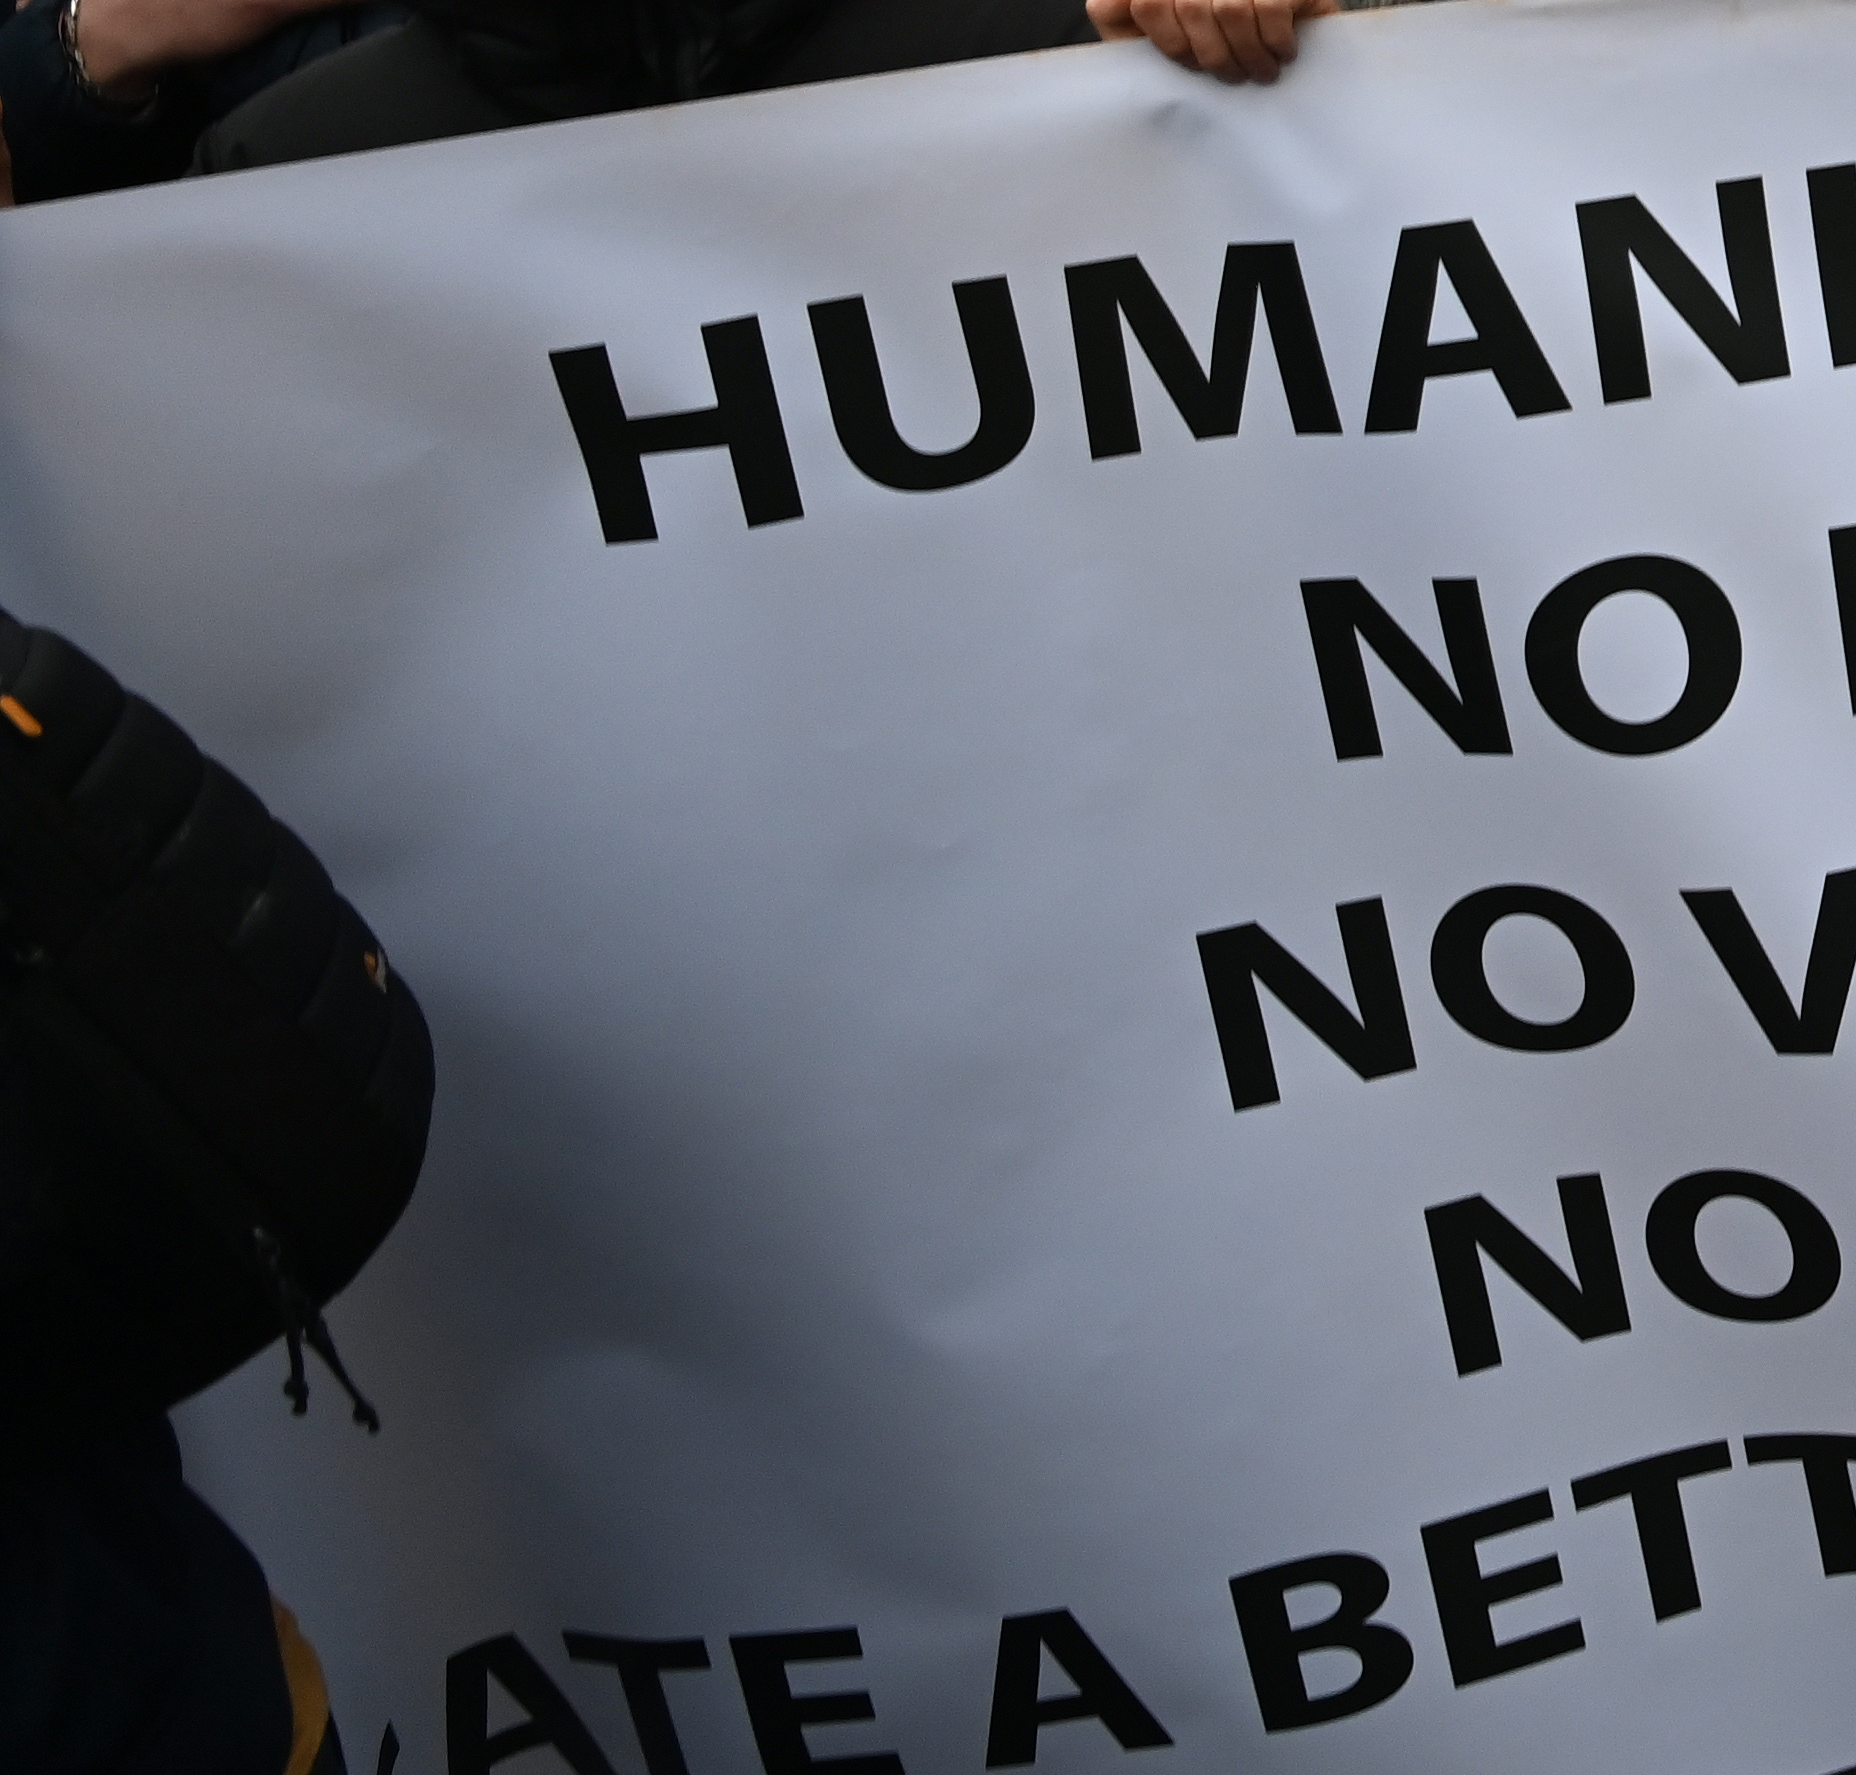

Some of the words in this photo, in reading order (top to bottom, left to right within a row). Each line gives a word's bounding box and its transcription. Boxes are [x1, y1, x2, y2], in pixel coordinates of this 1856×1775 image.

[1300, 556, 1741, 760] NO
[1196, 886, 1634, 1112] NO
[1424, 1170, 1841, 1377] NO
[376, 1625, 911, 1775] ATE
[985, 1607, 1174, 1773] A
